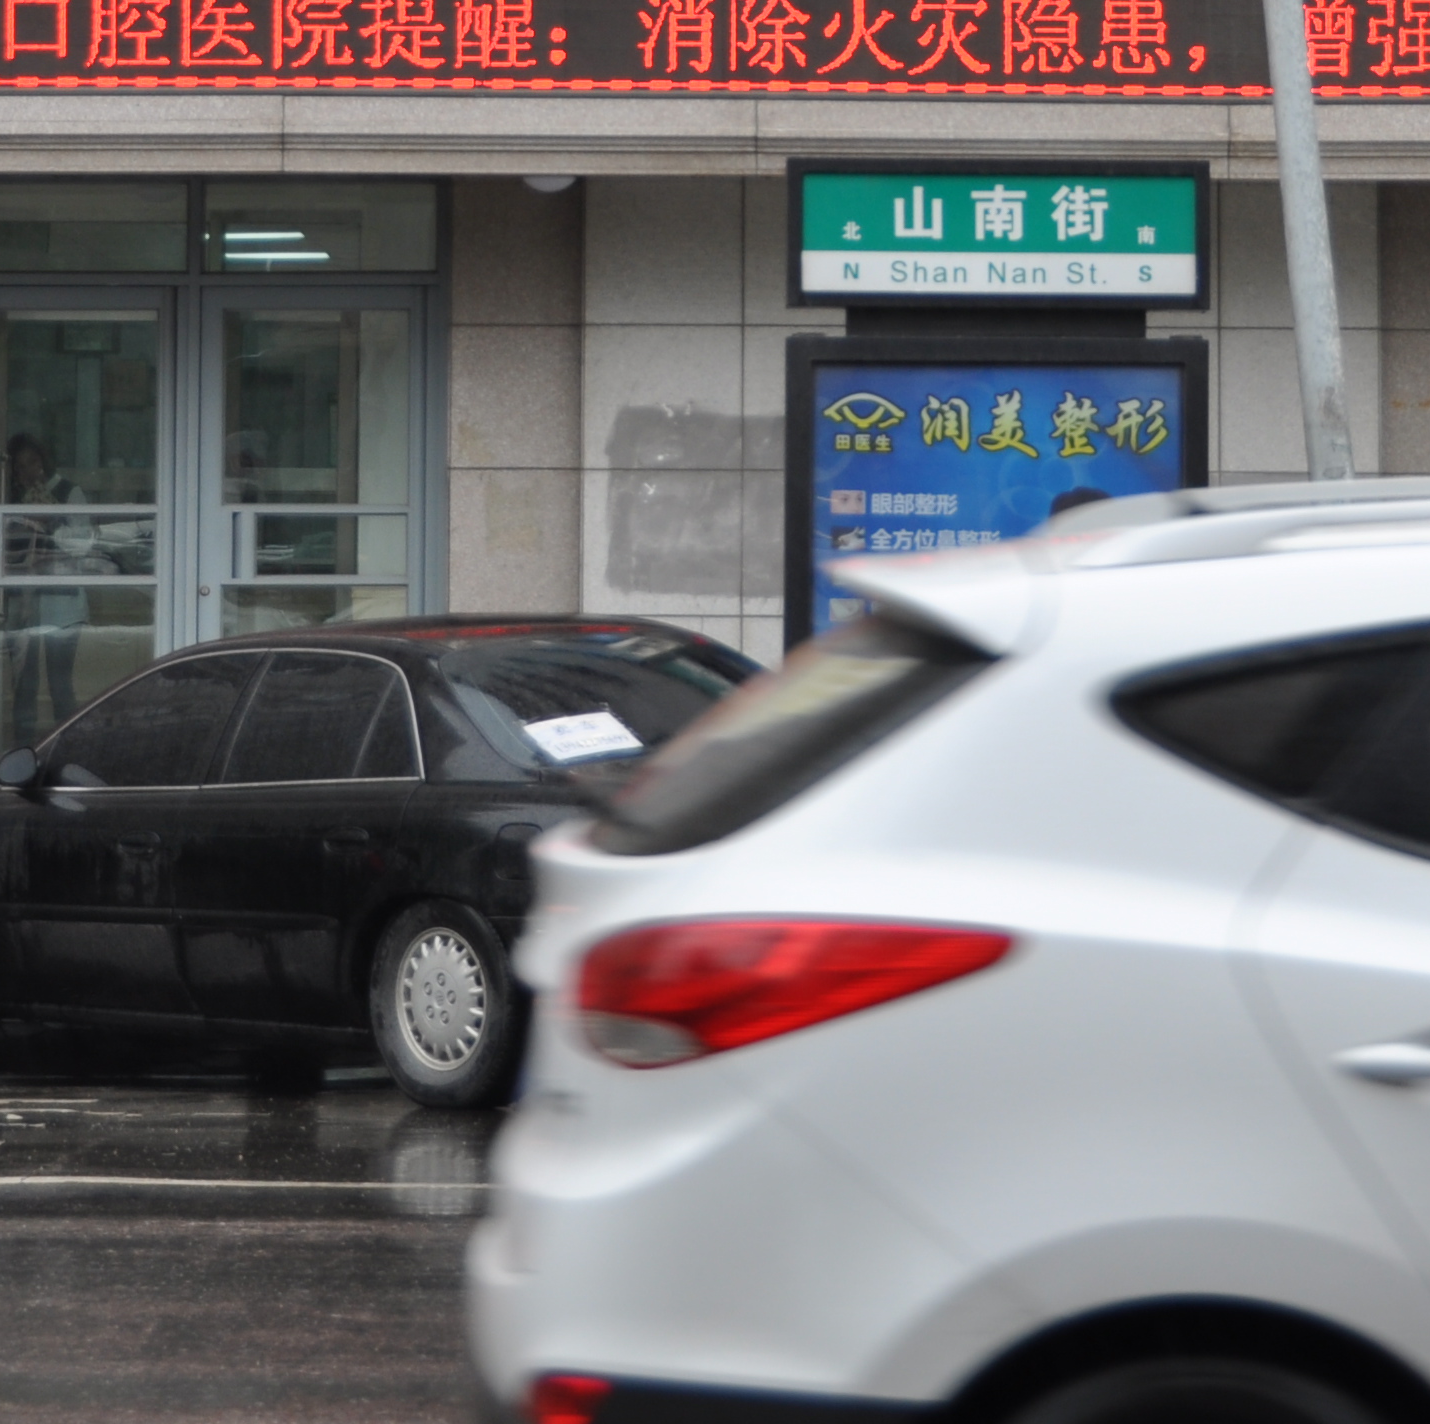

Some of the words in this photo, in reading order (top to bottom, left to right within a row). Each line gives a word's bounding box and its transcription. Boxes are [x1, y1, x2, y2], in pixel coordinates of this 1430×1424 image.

[842, 221, 861, 240] 北
[894, 185, 1108, 241] 山南街
[1137, 225, 1155, 244] 南
[844, 263, 859, 279] N
[890, 261, 967, 283] Shan
[987, 262, 1047, 284] Nan
[1066, 263, 1107, 284] St.
[1139, 266, 1152, 282] S
[921, 390, 1169, 458] 润美整形
[835, 434, 892, 451] 田医生
[872, 493, 958, 515] 眼部整形
